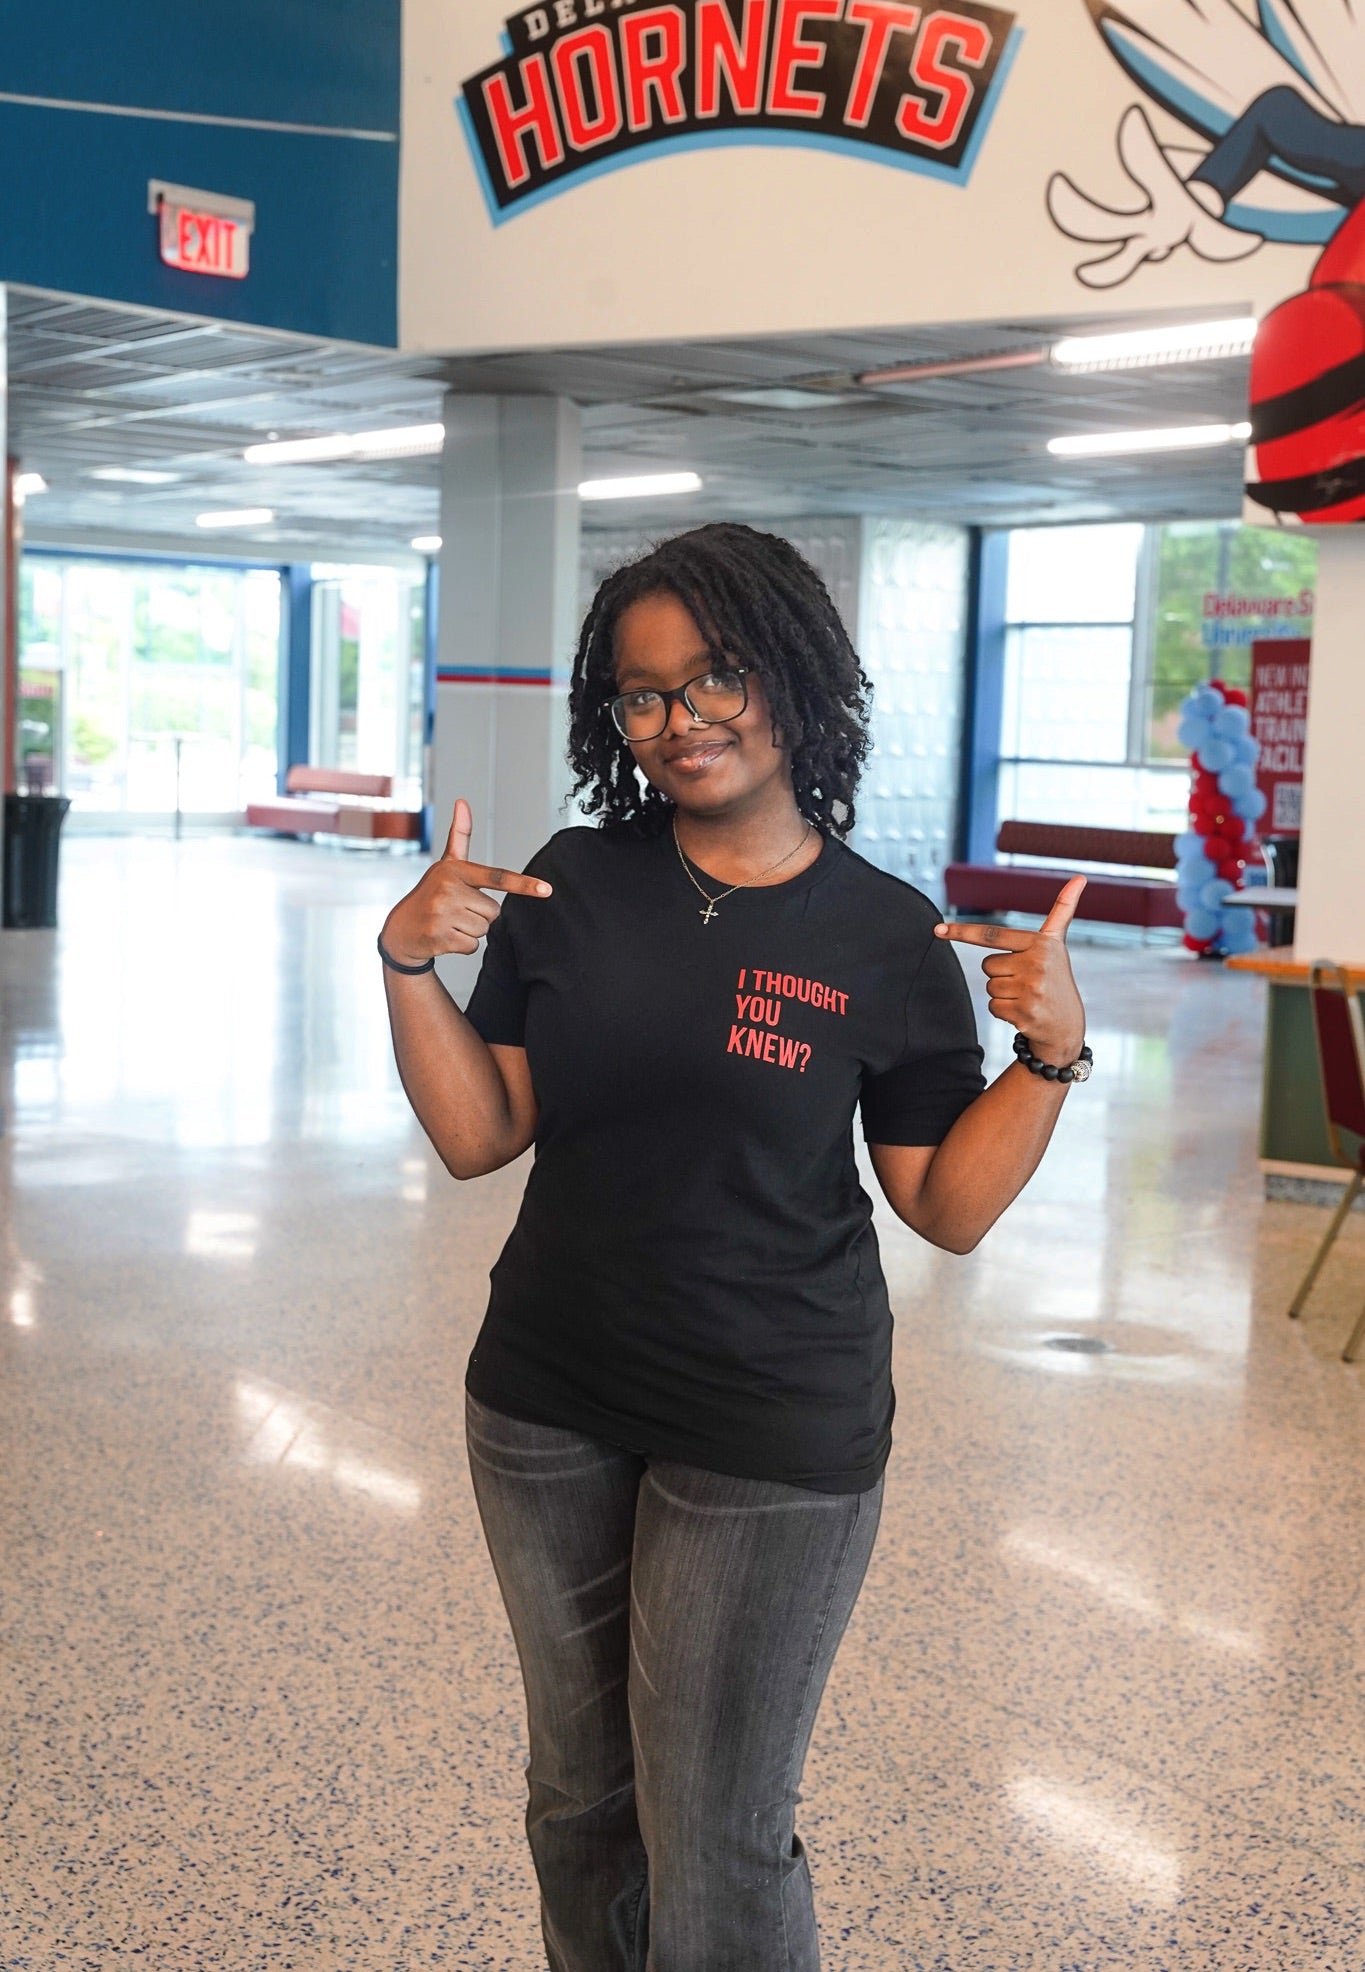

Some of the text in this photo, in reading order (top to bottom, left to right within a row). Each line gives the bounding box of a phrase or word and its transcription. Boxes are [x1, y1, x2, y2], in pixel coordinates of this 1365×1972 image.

[523, 0, 638, 41] DEL
[481, 0, 992, 188] HORNETS
[178, 209, 238, 271] EXIT
[1203, 592, 1297, 618] Delaware
[1260, 745, 1304, 772] ACIL
[735, 994, 782, 1026] YOU
[737, 968, 849, 1016] I THOUGHT
[726, 1024, 812, 1073] KNEW?
